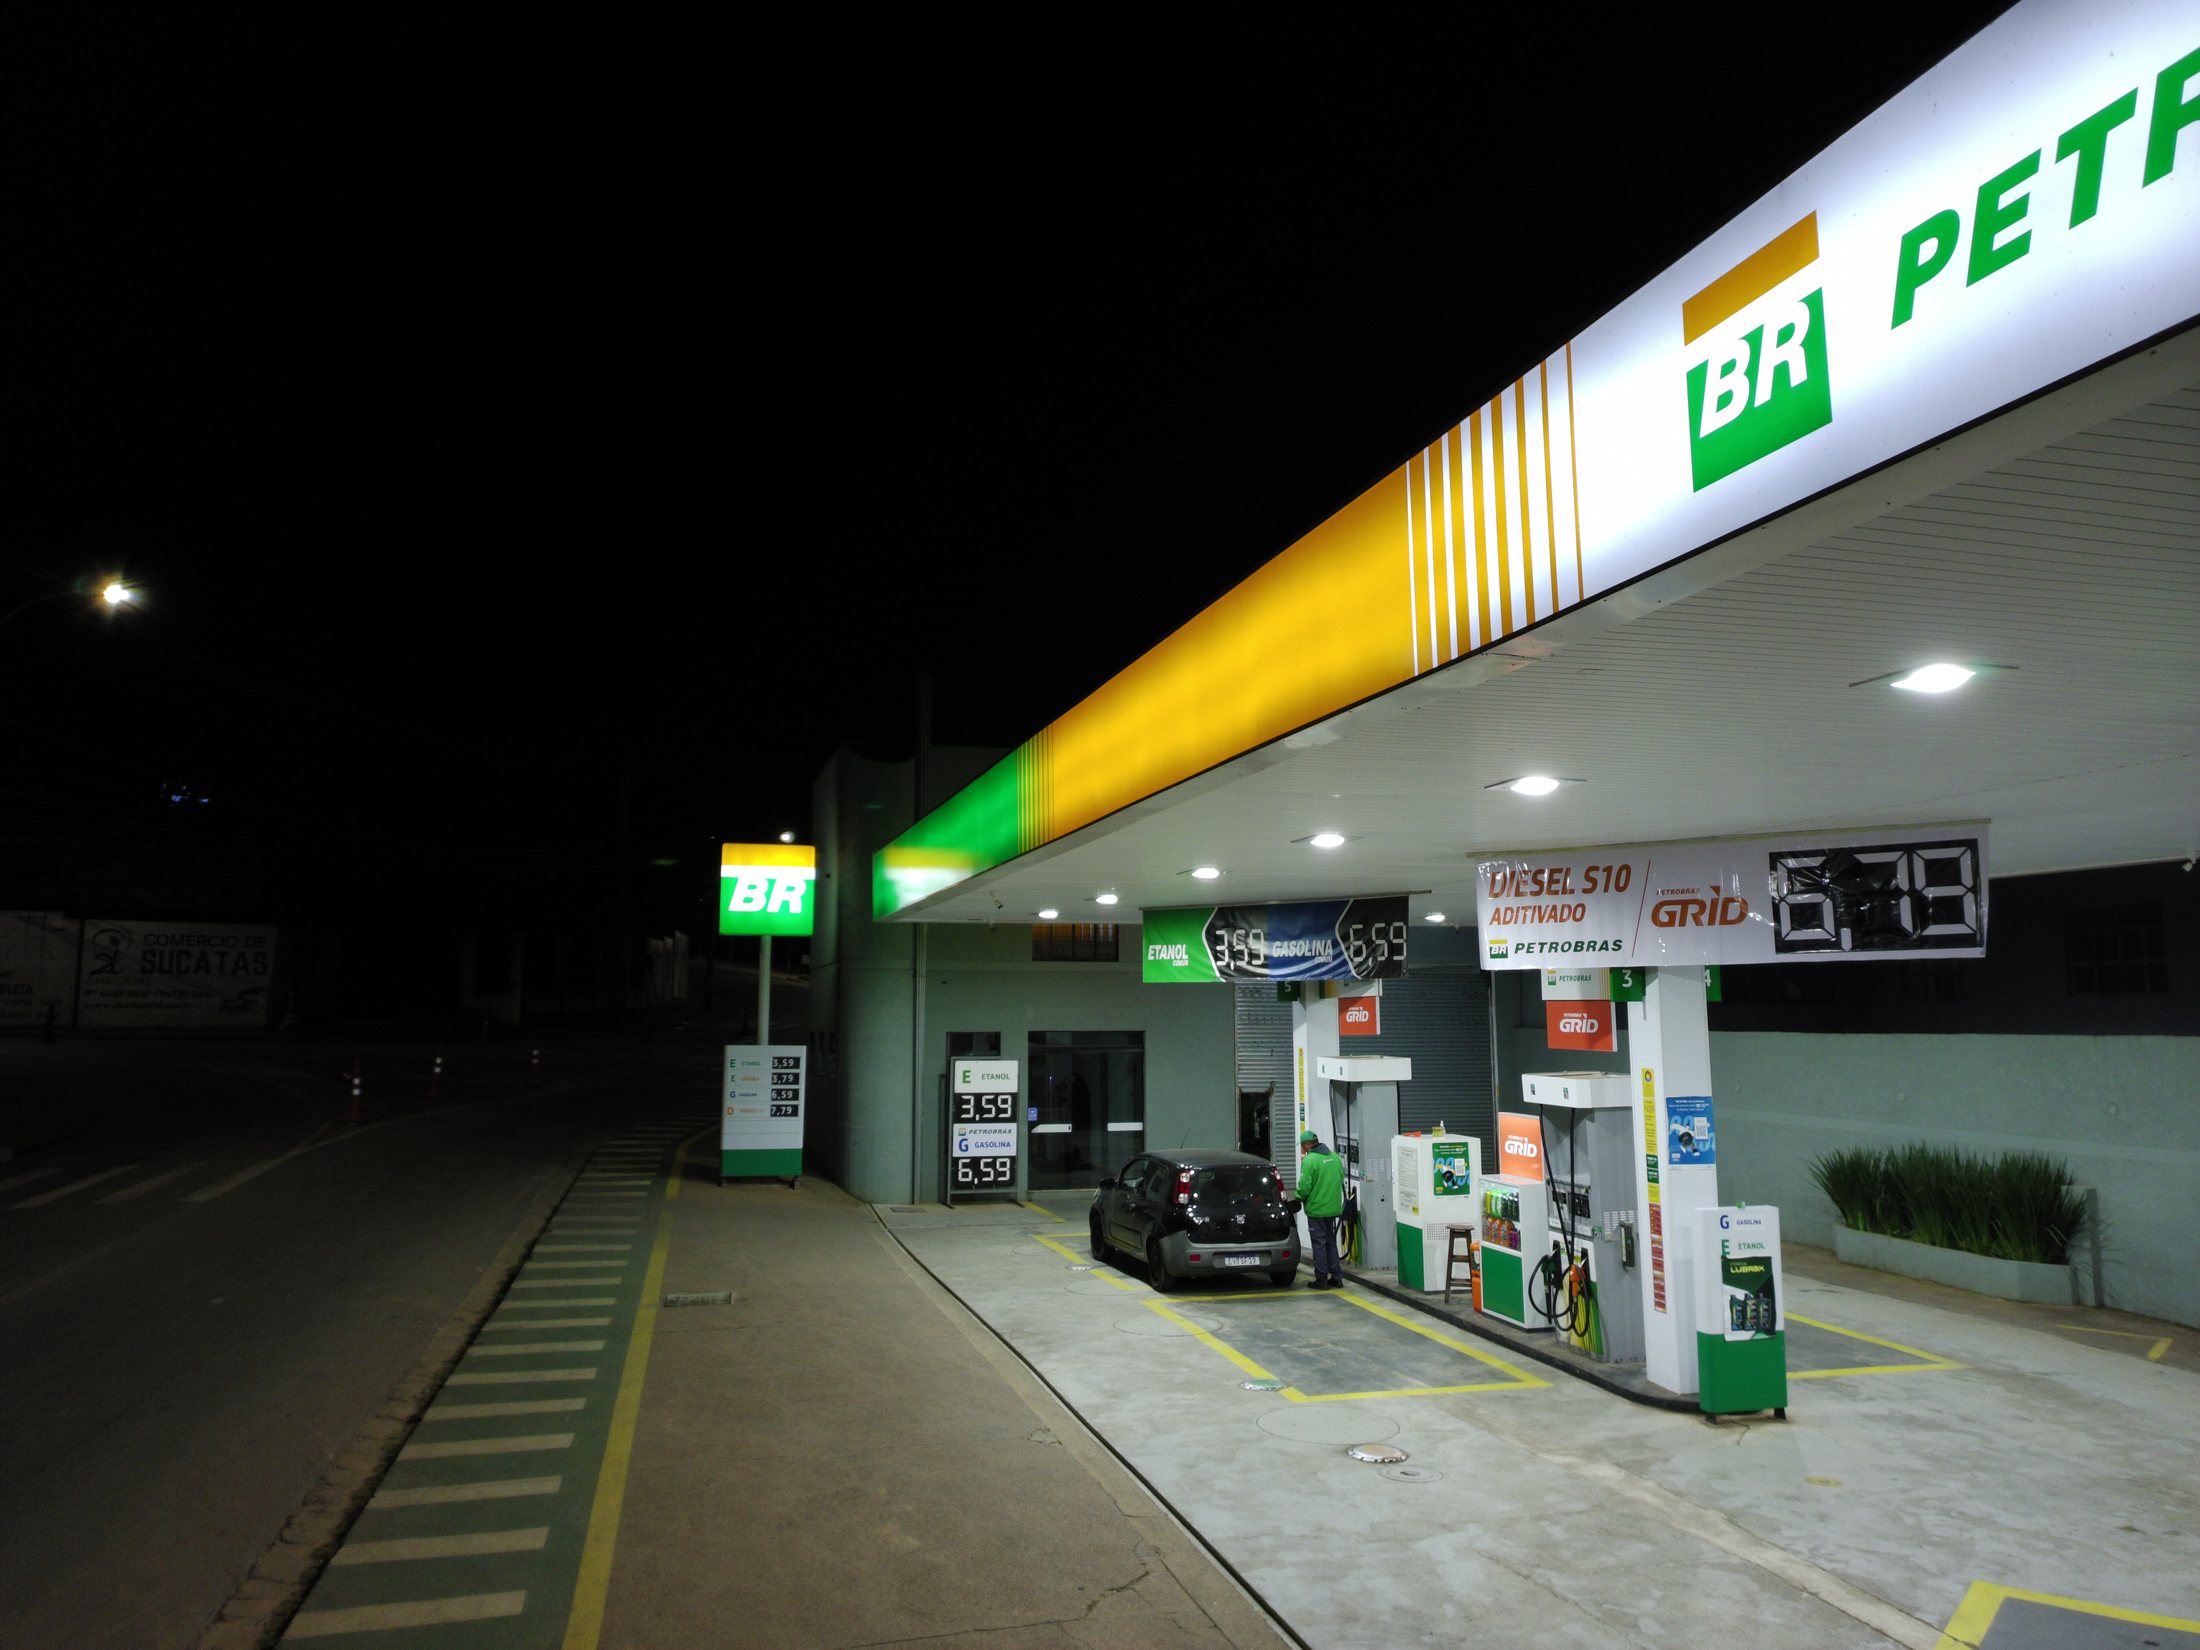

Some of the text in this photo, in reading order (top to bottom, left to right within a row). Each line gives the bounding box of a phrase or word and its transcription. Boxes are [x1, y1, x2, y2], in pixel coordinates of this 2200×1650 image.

[1698, 299, 1811, 439] BR
[1488, 863, 1632, 899] DIESEL S10
[728, 875, 808, 914] BR
[1488, 902, 1587, 926] ADITIVADO
[244, 935, 268, 948] DE
[1215, 928, 1265, 970] 3,59
[1272, 939, 1333, 958] GASOLINA
[1349, 921, 1407, 967] 6,59
[1514, 939, 1623, 954] PETROBRAS
[1147, 943, 1189, 961] ETANOL
[140, 949, 267, 976] SUCATAS
[1559, 974, 1592, 982] PETROBRAS
[1621, 968, 1633, 988] 3
[1346, 1006, 1369, 1022] GRID
[1559, 1013, 1599, 1034] GRID
[730, 1058, 736, 1068] E
[772, 1058, 794, 1068] 3,59
[771, 1074, 794, 1084] 3,79
[962, 1069, 971, 1084] E
[771, 1090, 793, 1100] 6,59
[770, 1106, 793, 1116] 7,79
[960, 1095, 1012, 1121] 3,59
[958, 1138, 969, 1152] G
[1504, 1136, 1538, 1158] GRID
[957, 1158, 1011, 1184] 6,59
[1719, 1214, 1730, 1230] G
[1721, 1239, 1765, 1255] E ETANOL
